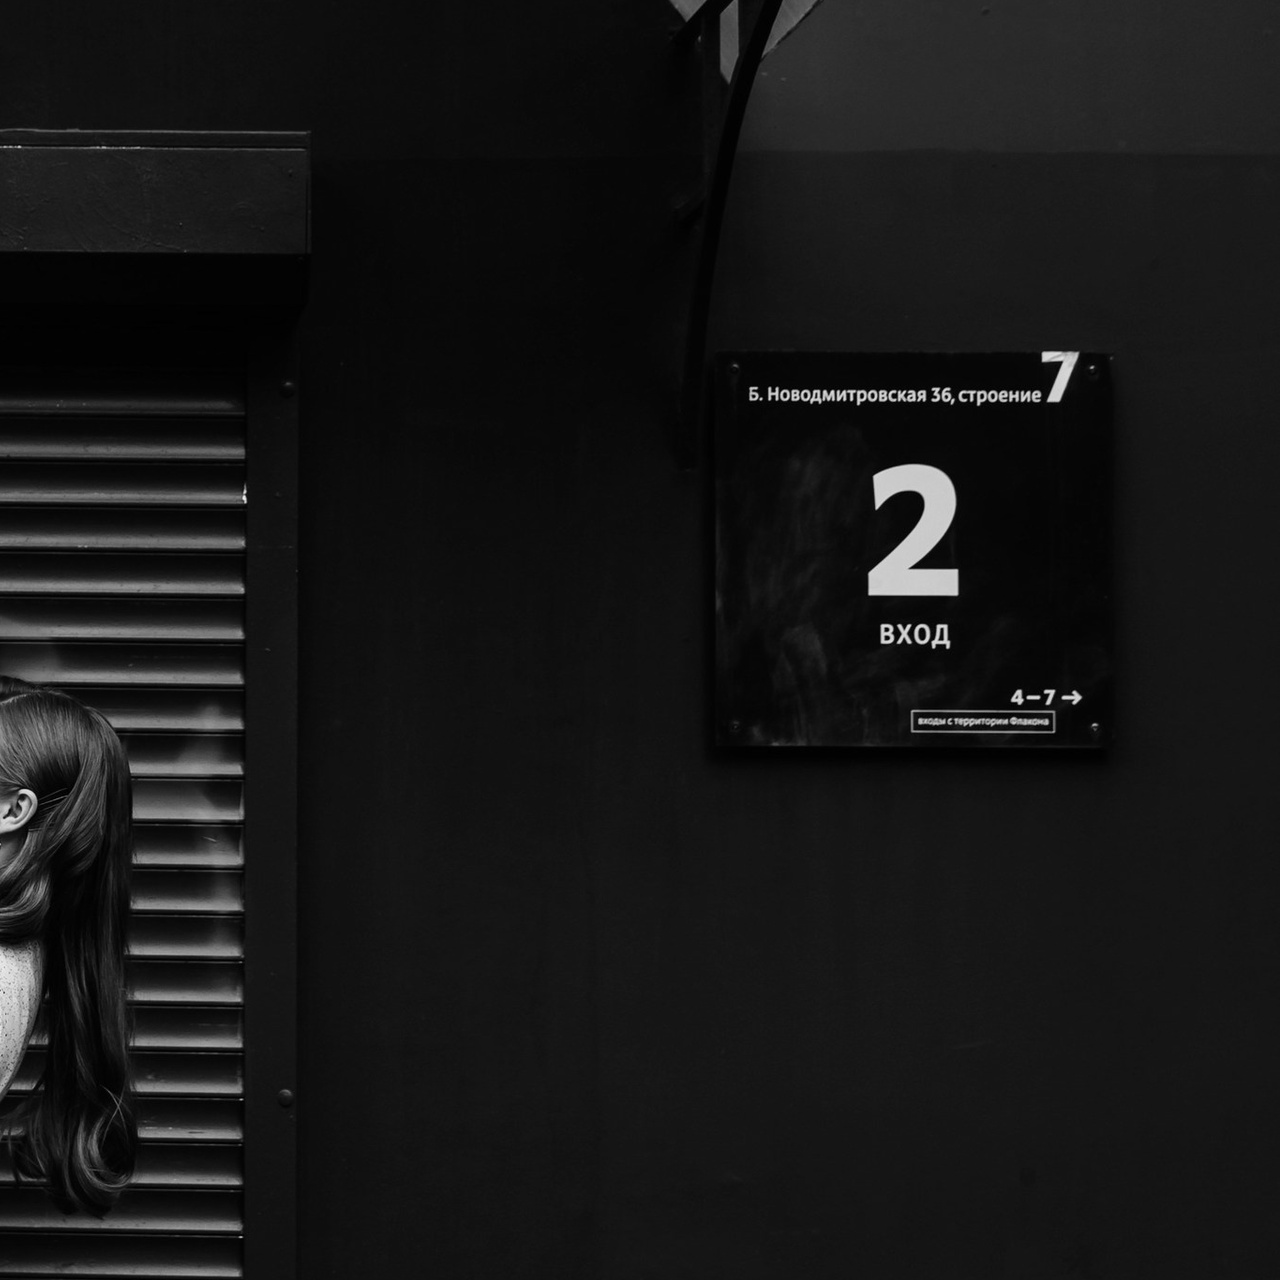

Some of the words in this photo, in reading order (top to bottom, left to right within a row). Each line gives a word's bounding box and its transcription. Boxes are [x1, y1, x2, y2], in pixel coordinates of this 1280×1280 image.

[748, 386, 764, 402] Б.
[767, 386, 927, 407] Новодмитровская
[930, 386, 956, 406] 36,
[957, 389, 1042, 407] строение
[1040, 350, 1080, 403] 7
[867, 463, 960, 597] 2
[879, 623, 951, 650] ВХОД
[918, 717, 947, 727] входы
[954, 717, 1009, 728] территории
[1009, 715, 1050, 726] Флакона
